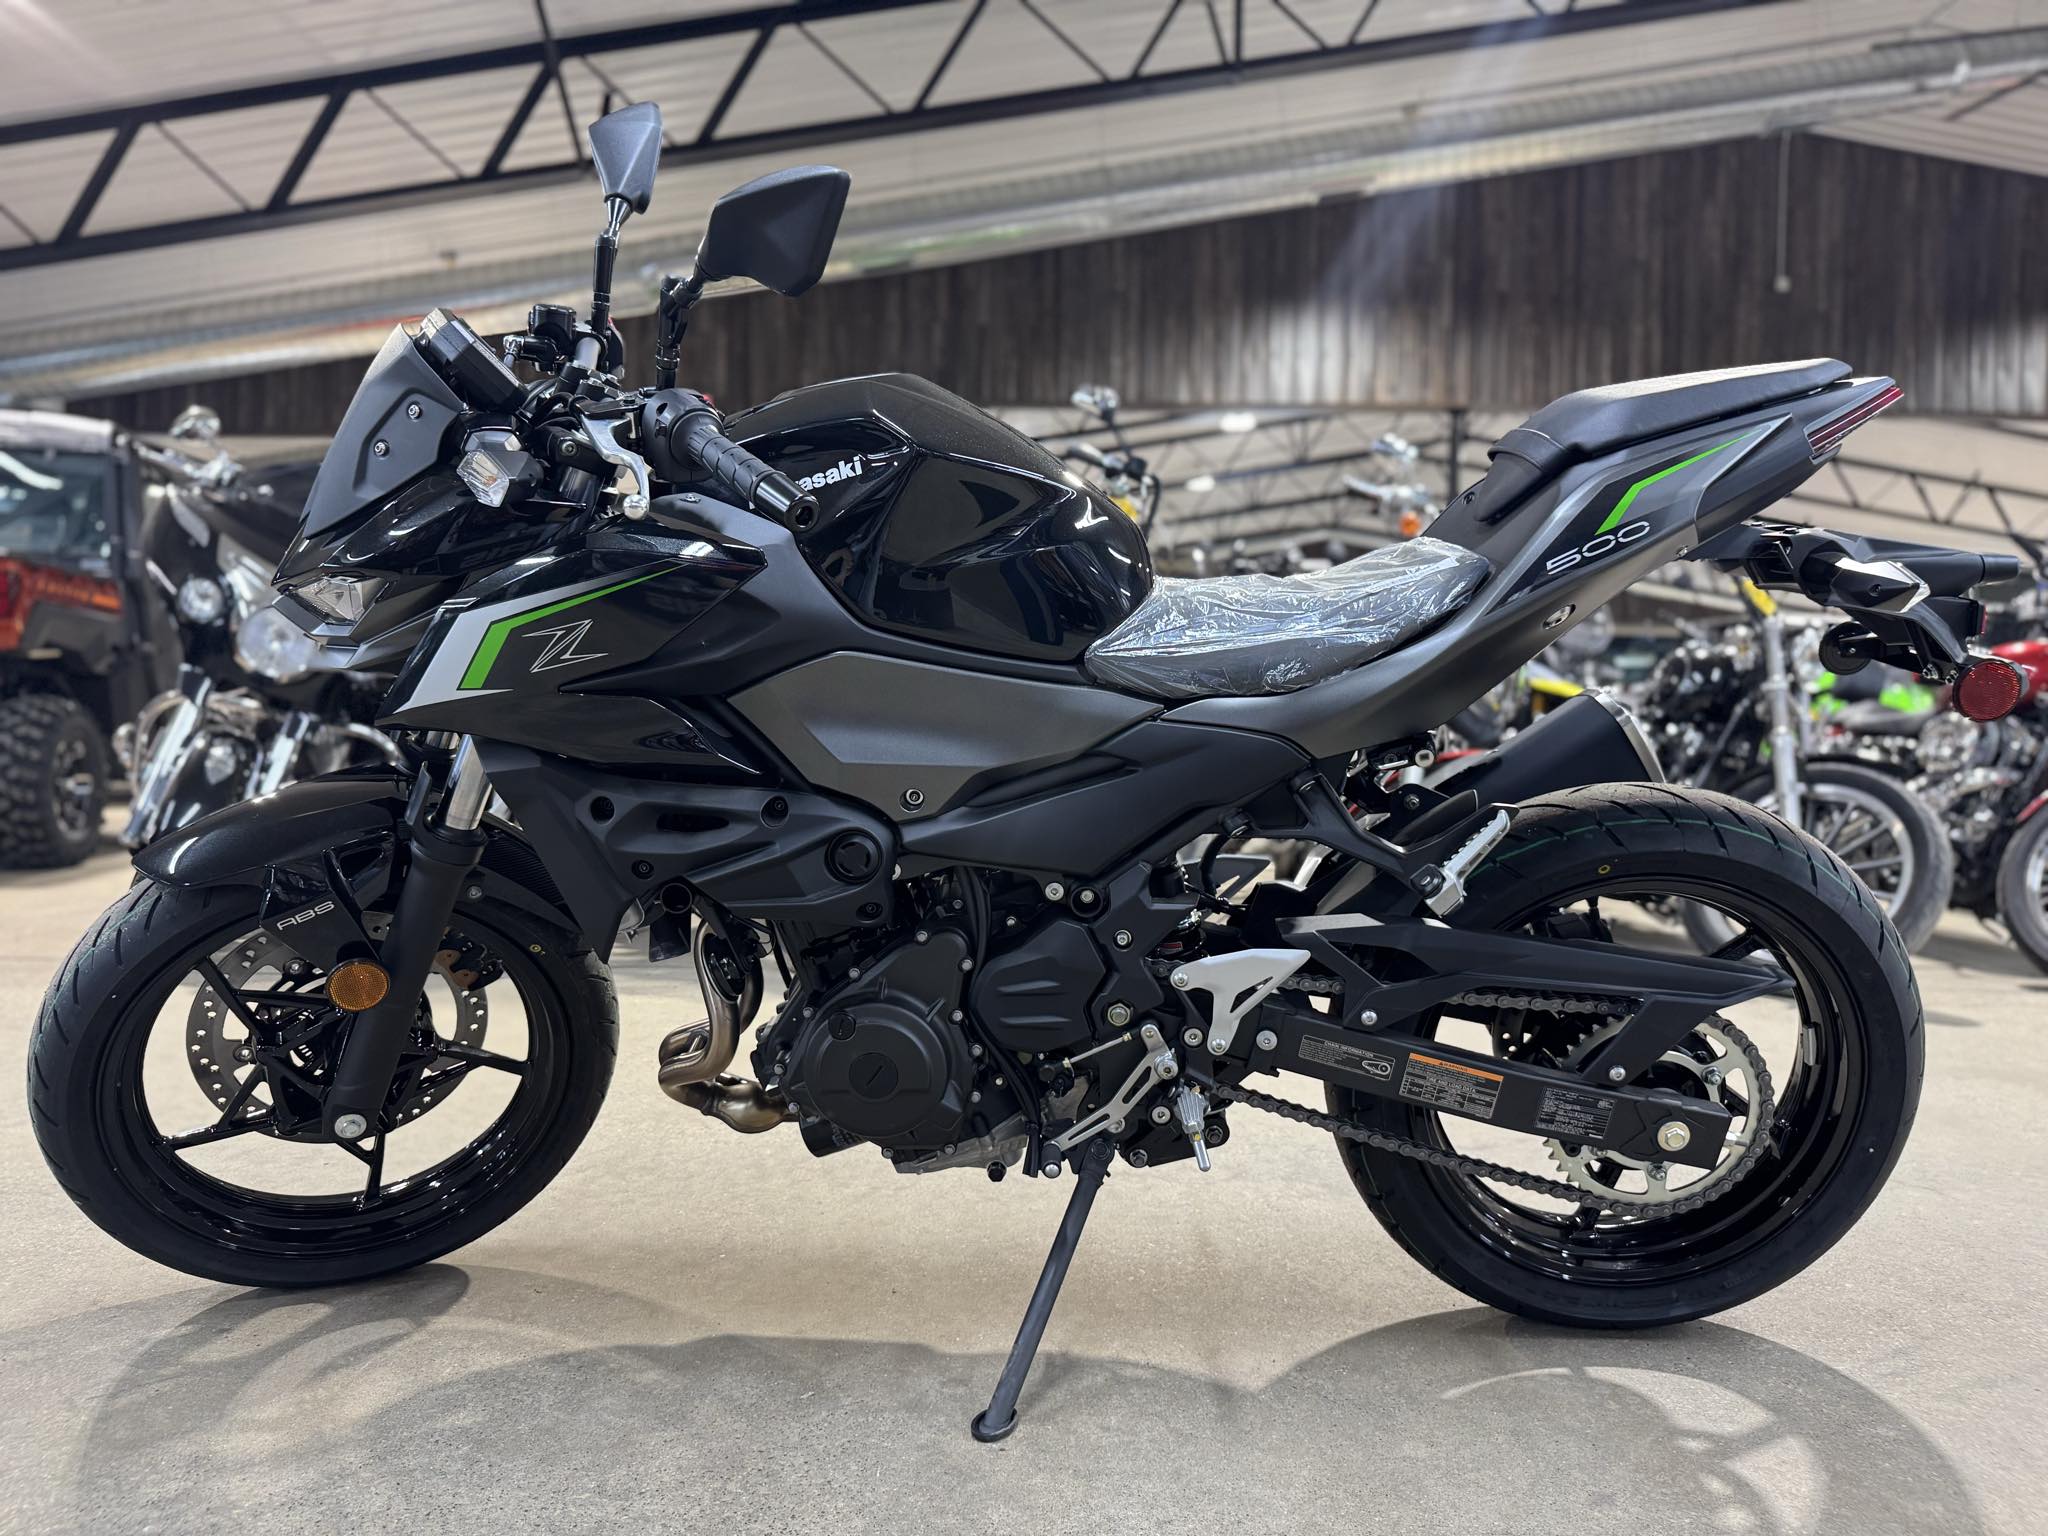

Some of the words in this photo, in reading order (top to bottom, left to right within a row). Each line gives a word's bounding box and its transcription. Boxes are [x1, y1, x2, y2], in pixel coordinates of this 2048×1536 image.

[795, 455, 863, 491] asaki
[1546, 521, 1650, 575] 500
[521, 618, 608, 673] Z
[276, 901, 335, 930] ABS
